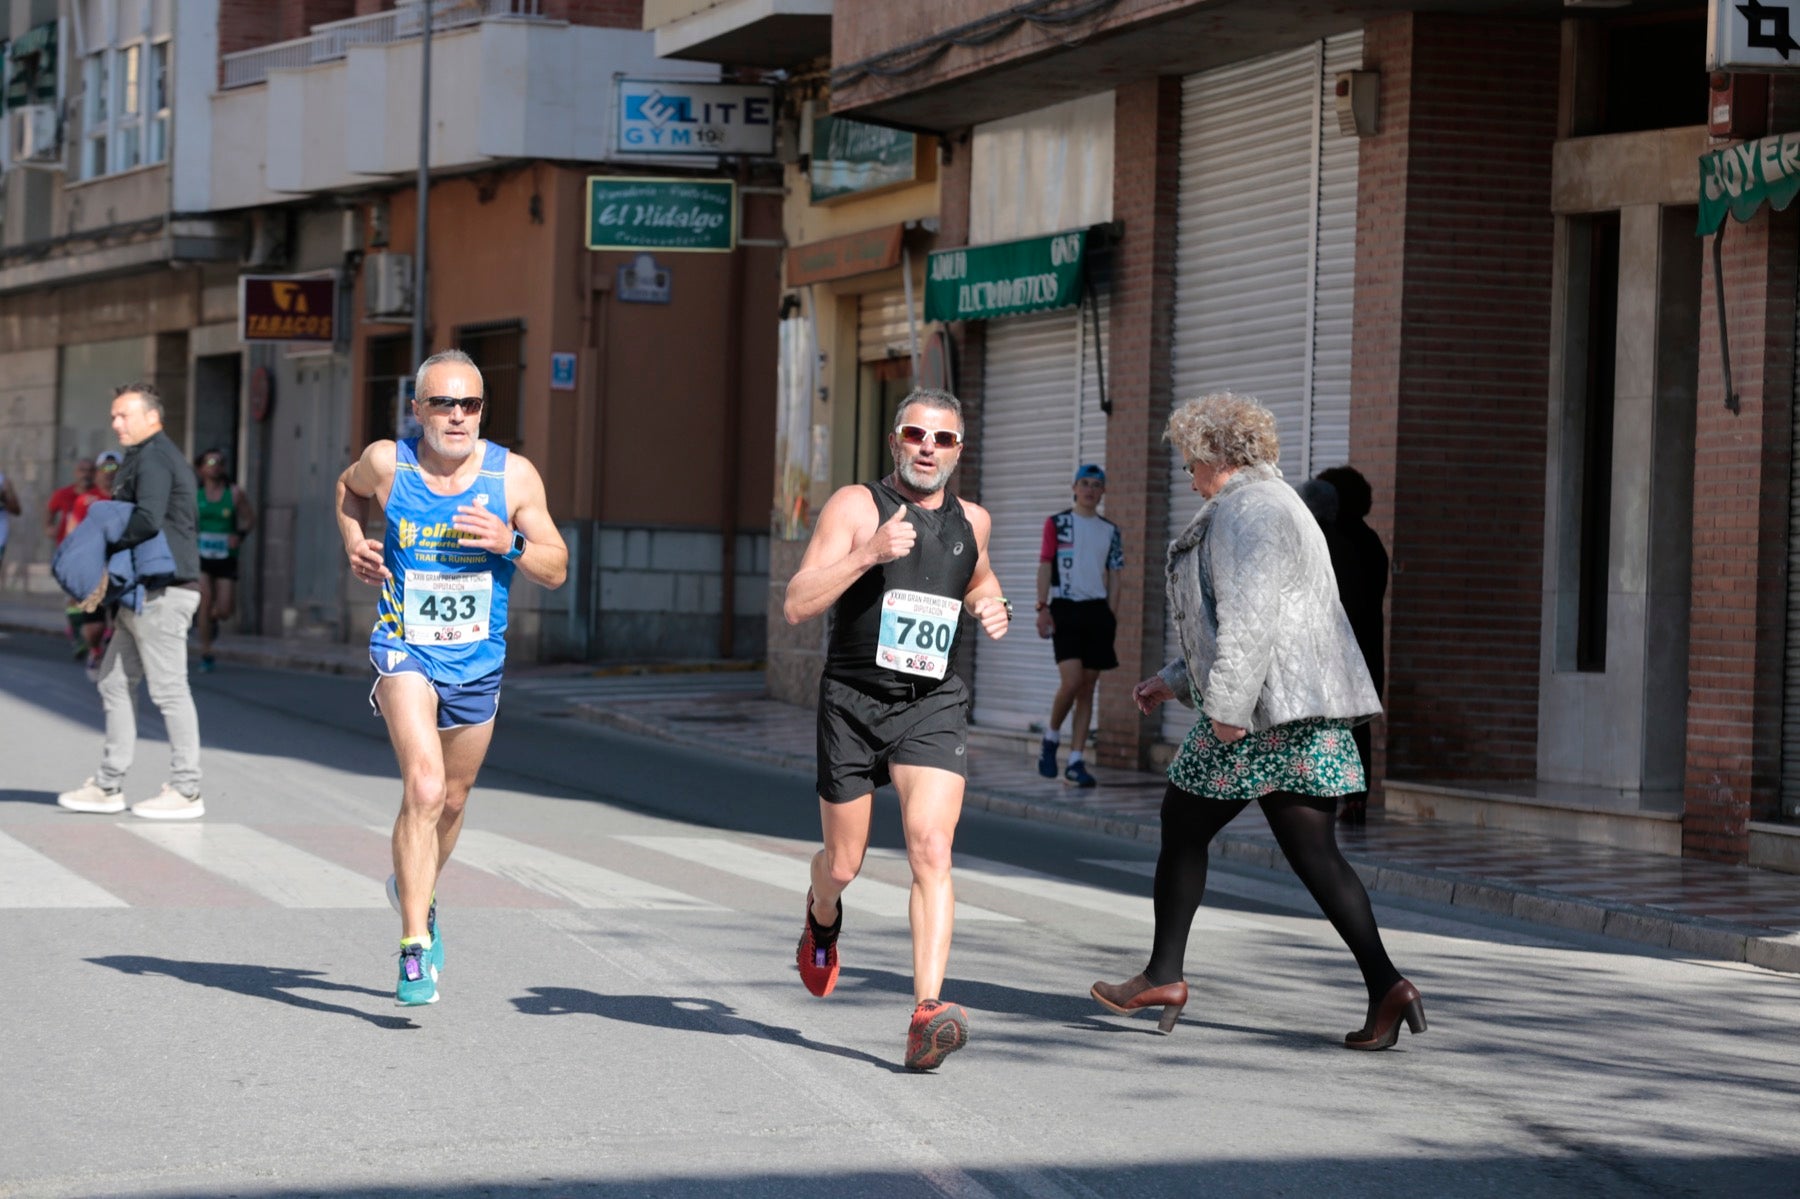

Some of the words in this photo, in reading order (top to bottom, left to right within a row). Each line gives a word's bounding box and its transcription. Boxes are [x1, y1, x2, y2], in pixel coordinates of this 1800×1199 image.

[640, 89, 770, 129] ELITE
[625, 128, 692, 146] GYM
[1704, 131, 1800, 201] JOYER
[599, 204, 630, 226] El
[632, 204, 724, 234] Hidalgo
[248, 314, 332, 337] TABACOS
[414, 553, 437, 561] TRAIL
[448, 555, 487, 564] RUNNING
[419, 595, 477, 622] 433
[897, 616, 950, 653] 780
